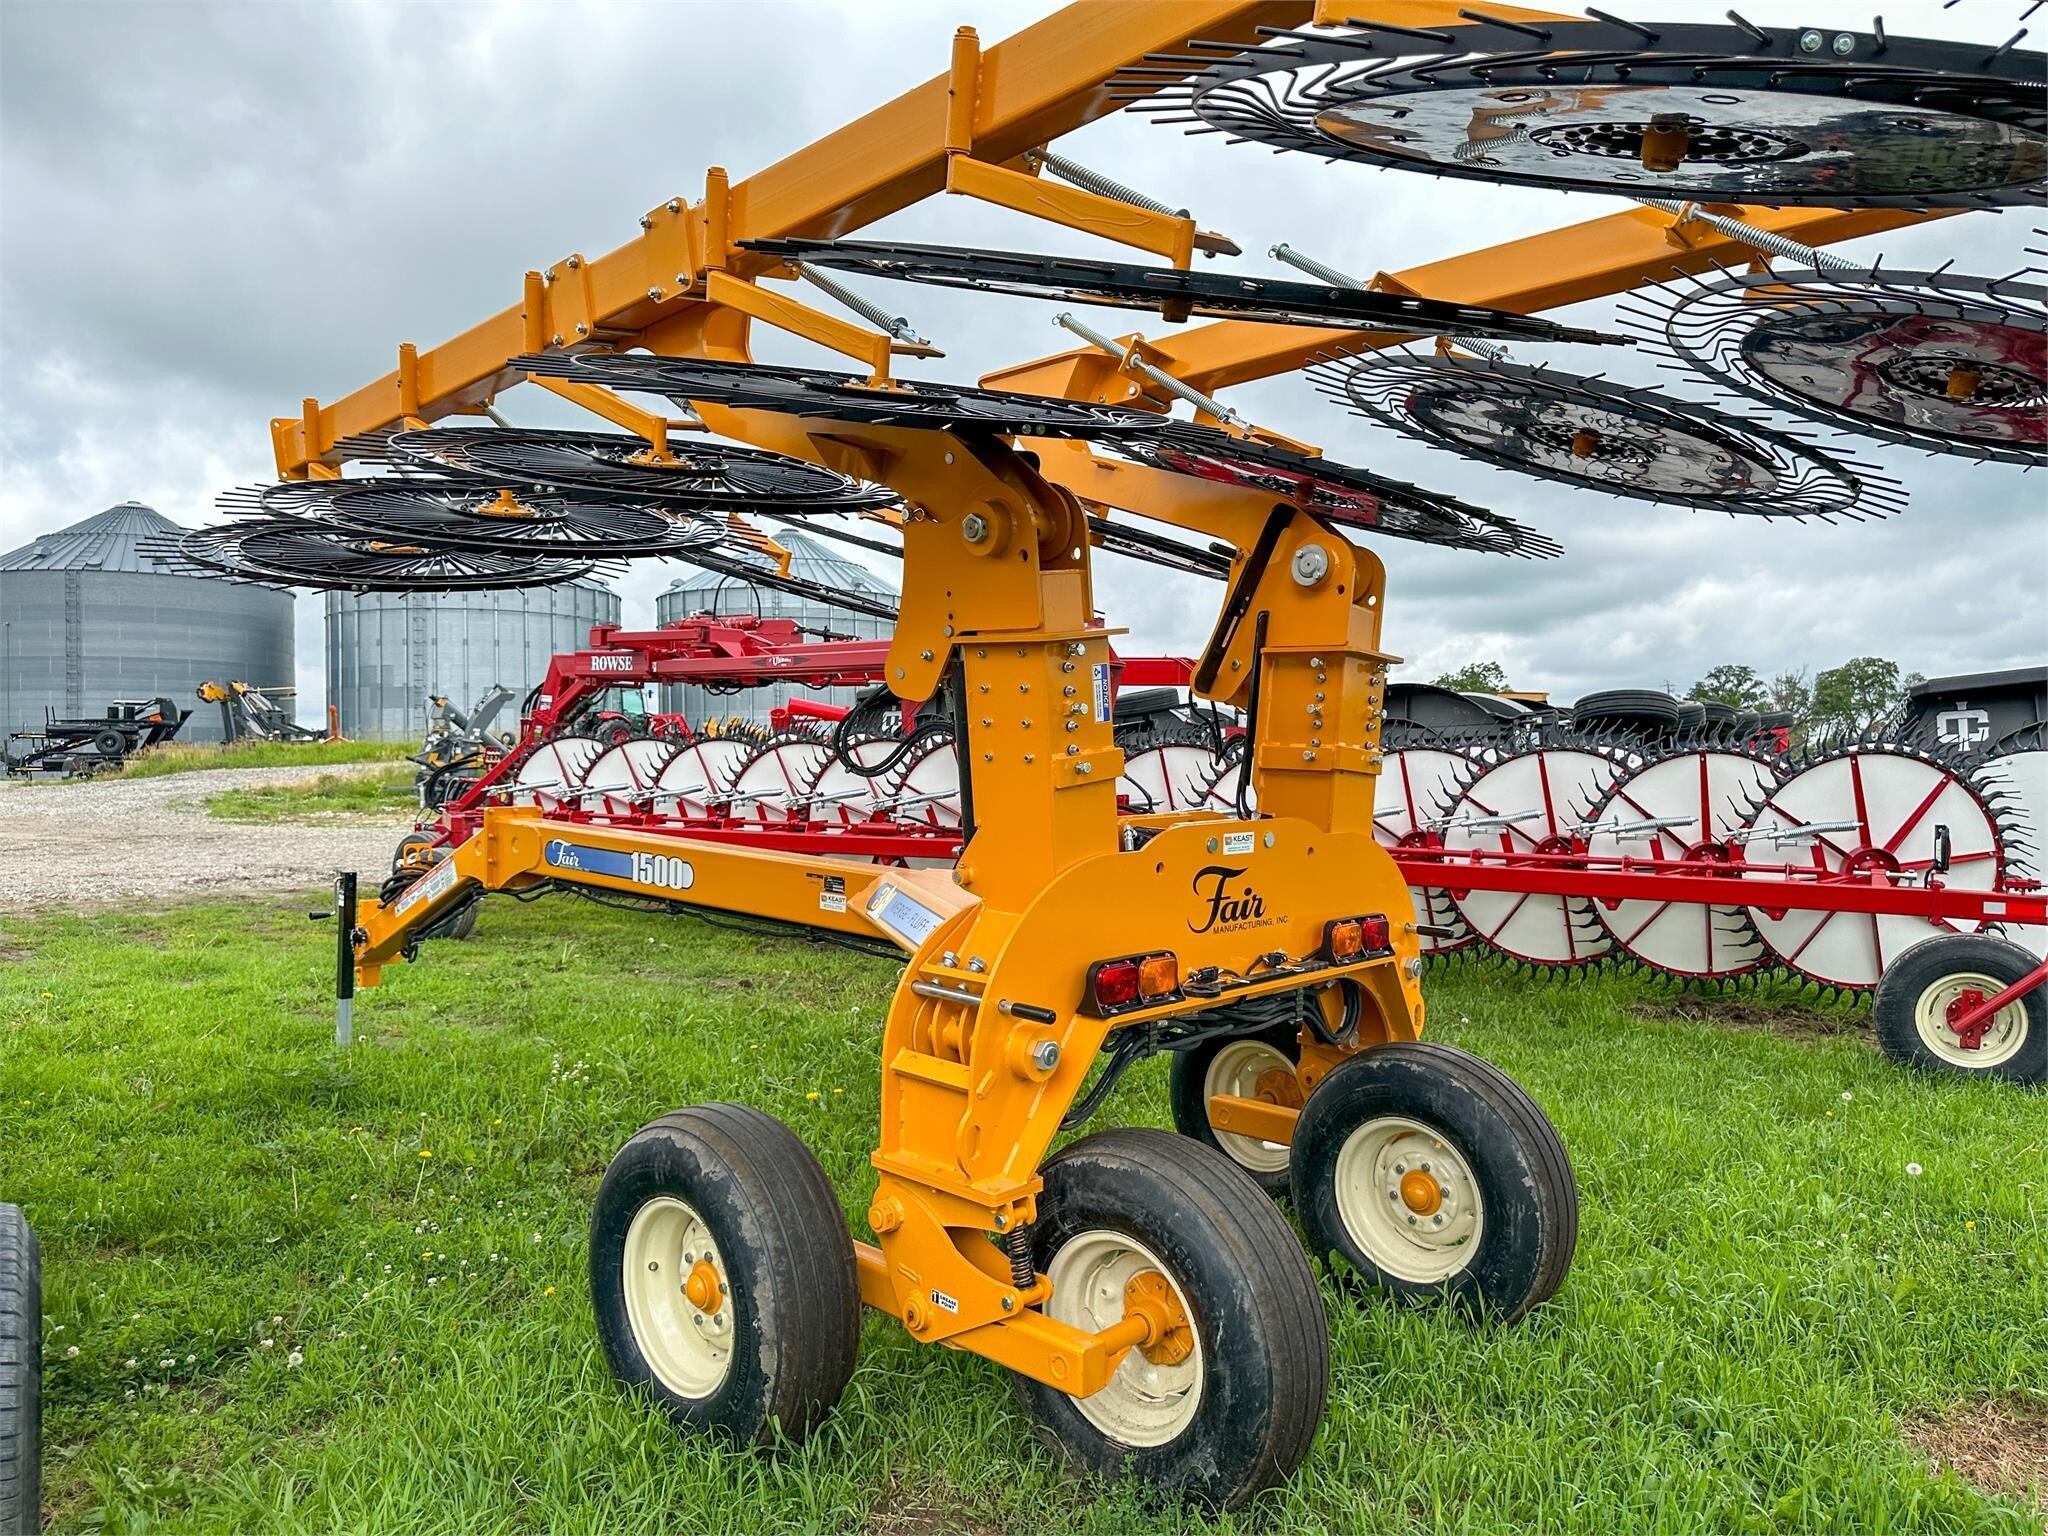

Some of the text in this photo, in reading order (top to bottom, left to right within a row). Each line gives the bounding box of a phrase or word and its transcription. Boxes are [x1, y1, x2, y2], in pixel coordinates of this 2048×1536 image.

[591, 655, 633, 671] ROWSE
[552, 838, 580, 867] Fair
[630, 851, 684, 890] 1500
[1187, 865, 1267, 934] Fair
